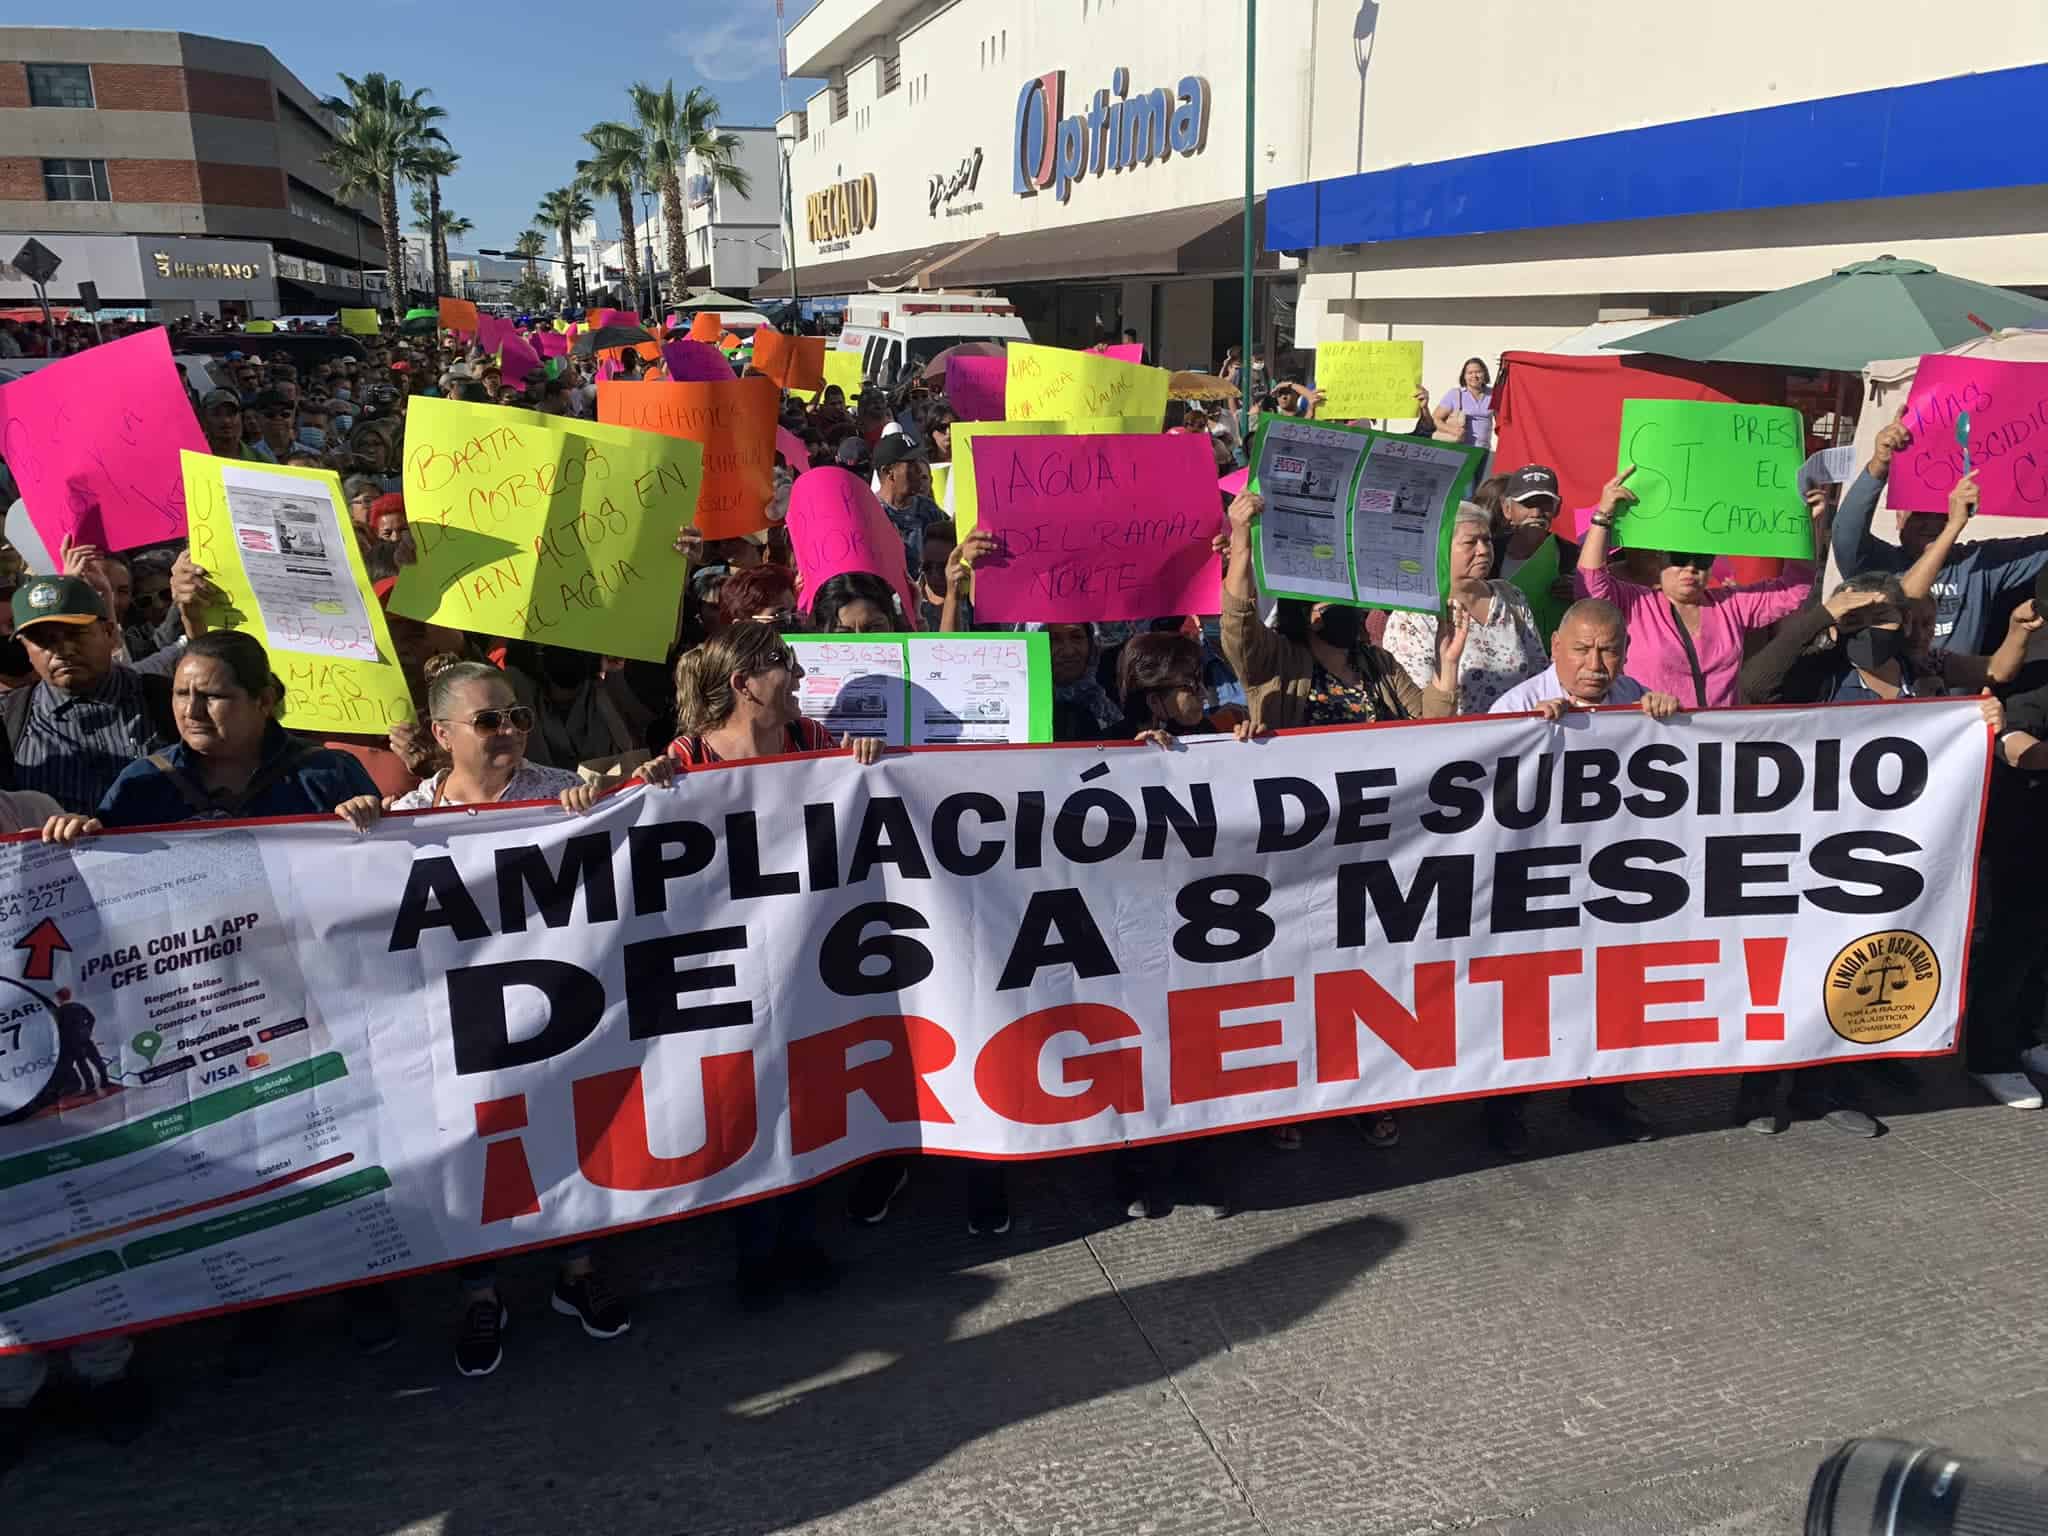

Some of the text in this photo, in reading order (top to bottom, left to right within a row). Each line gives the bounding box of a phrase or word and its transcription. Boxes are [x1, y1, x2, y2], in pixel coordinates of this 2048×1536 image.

[1013, 67, 1209, 203] Optima
[408, 427, 524, 492] BASTA
[1756, 459, 1788, 489] EL
[469, 445, 609, 534] COBROS
[440, 559, 522, 612] TAN
[534, 497, 628, 568] ALTOS
[634, 463, 688, 509] EN
[998, 512, 1208, 559] DEL RAMAL
[560, 559, 643, 612] AGUA
[1029, 562, 1150, 601] NORTE
[288, 662, 363, 698] MAS
[389, 736, 1929, 952] AMPLIACIÓN DE SUBSIDIO
[81, 912, 259, 982] ¡PAGA CON LA APP
[111, 936, 242, 990] CFE CONTIGO!
[446, 830, 1925, 1075] DE 6 A 8 MESES
[1832, 937, 1933, 989] UNION DE USUARIOS
[144, 986, 189, 1006] Reporta
[150, 998, 197, 1019] Localiza
[155, 1014, 198, 1032] Conoce
[200, 1008, 213, 1018] tu
[177, 1023, 239, 1050] Disponible
[201, 1064, 240, 1085] VISA
[474, 937, 1787, 1225] ¡URGENTE!
